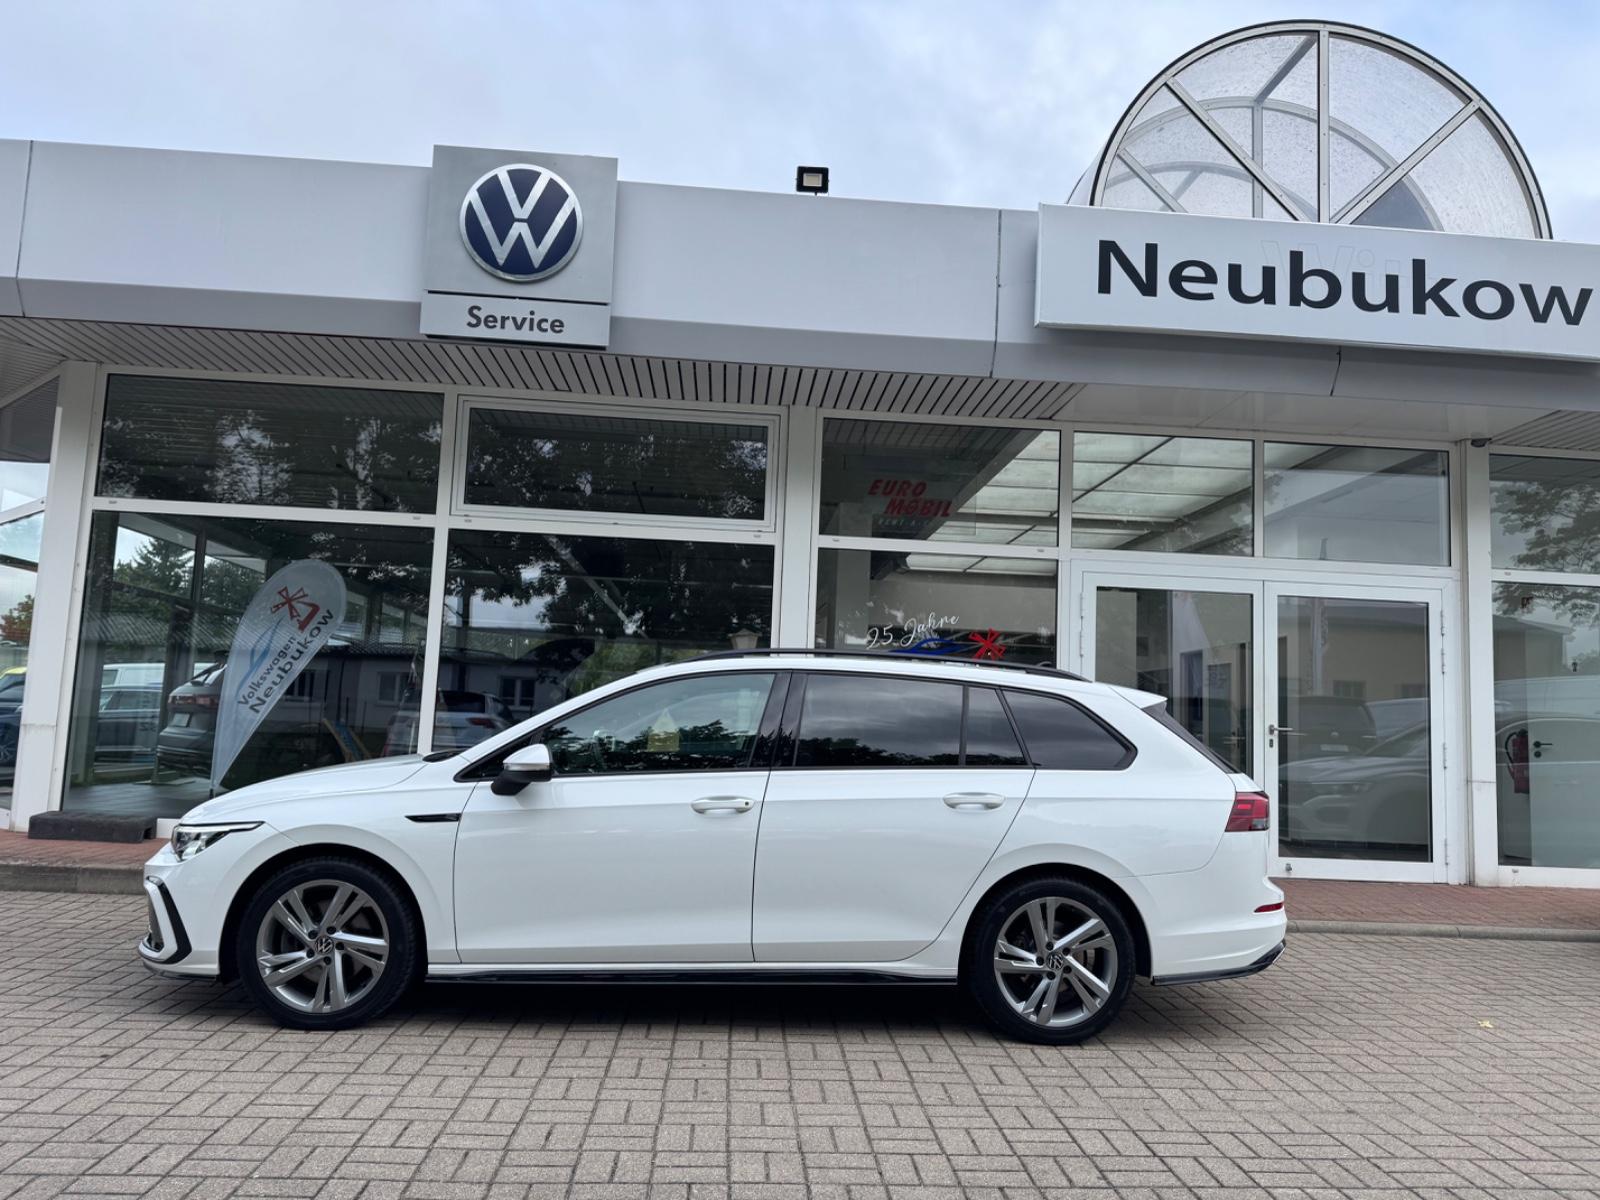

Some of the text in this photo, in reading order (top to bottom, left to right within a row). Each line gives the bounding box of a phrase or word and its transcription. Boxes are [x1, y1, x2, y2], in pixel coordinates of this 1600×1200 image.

[460, 165, 581, 280] VW
[1098, 239, 1593, 326] Neubukow
[467, 305, 565, 334] Service
[867, 479, 927, 497] EURO
[249, 608, 334, 714] Neubukow
[866, 611, 960, 650] 25 Jahre
[238, 636, 297, 706] Volkswagen
